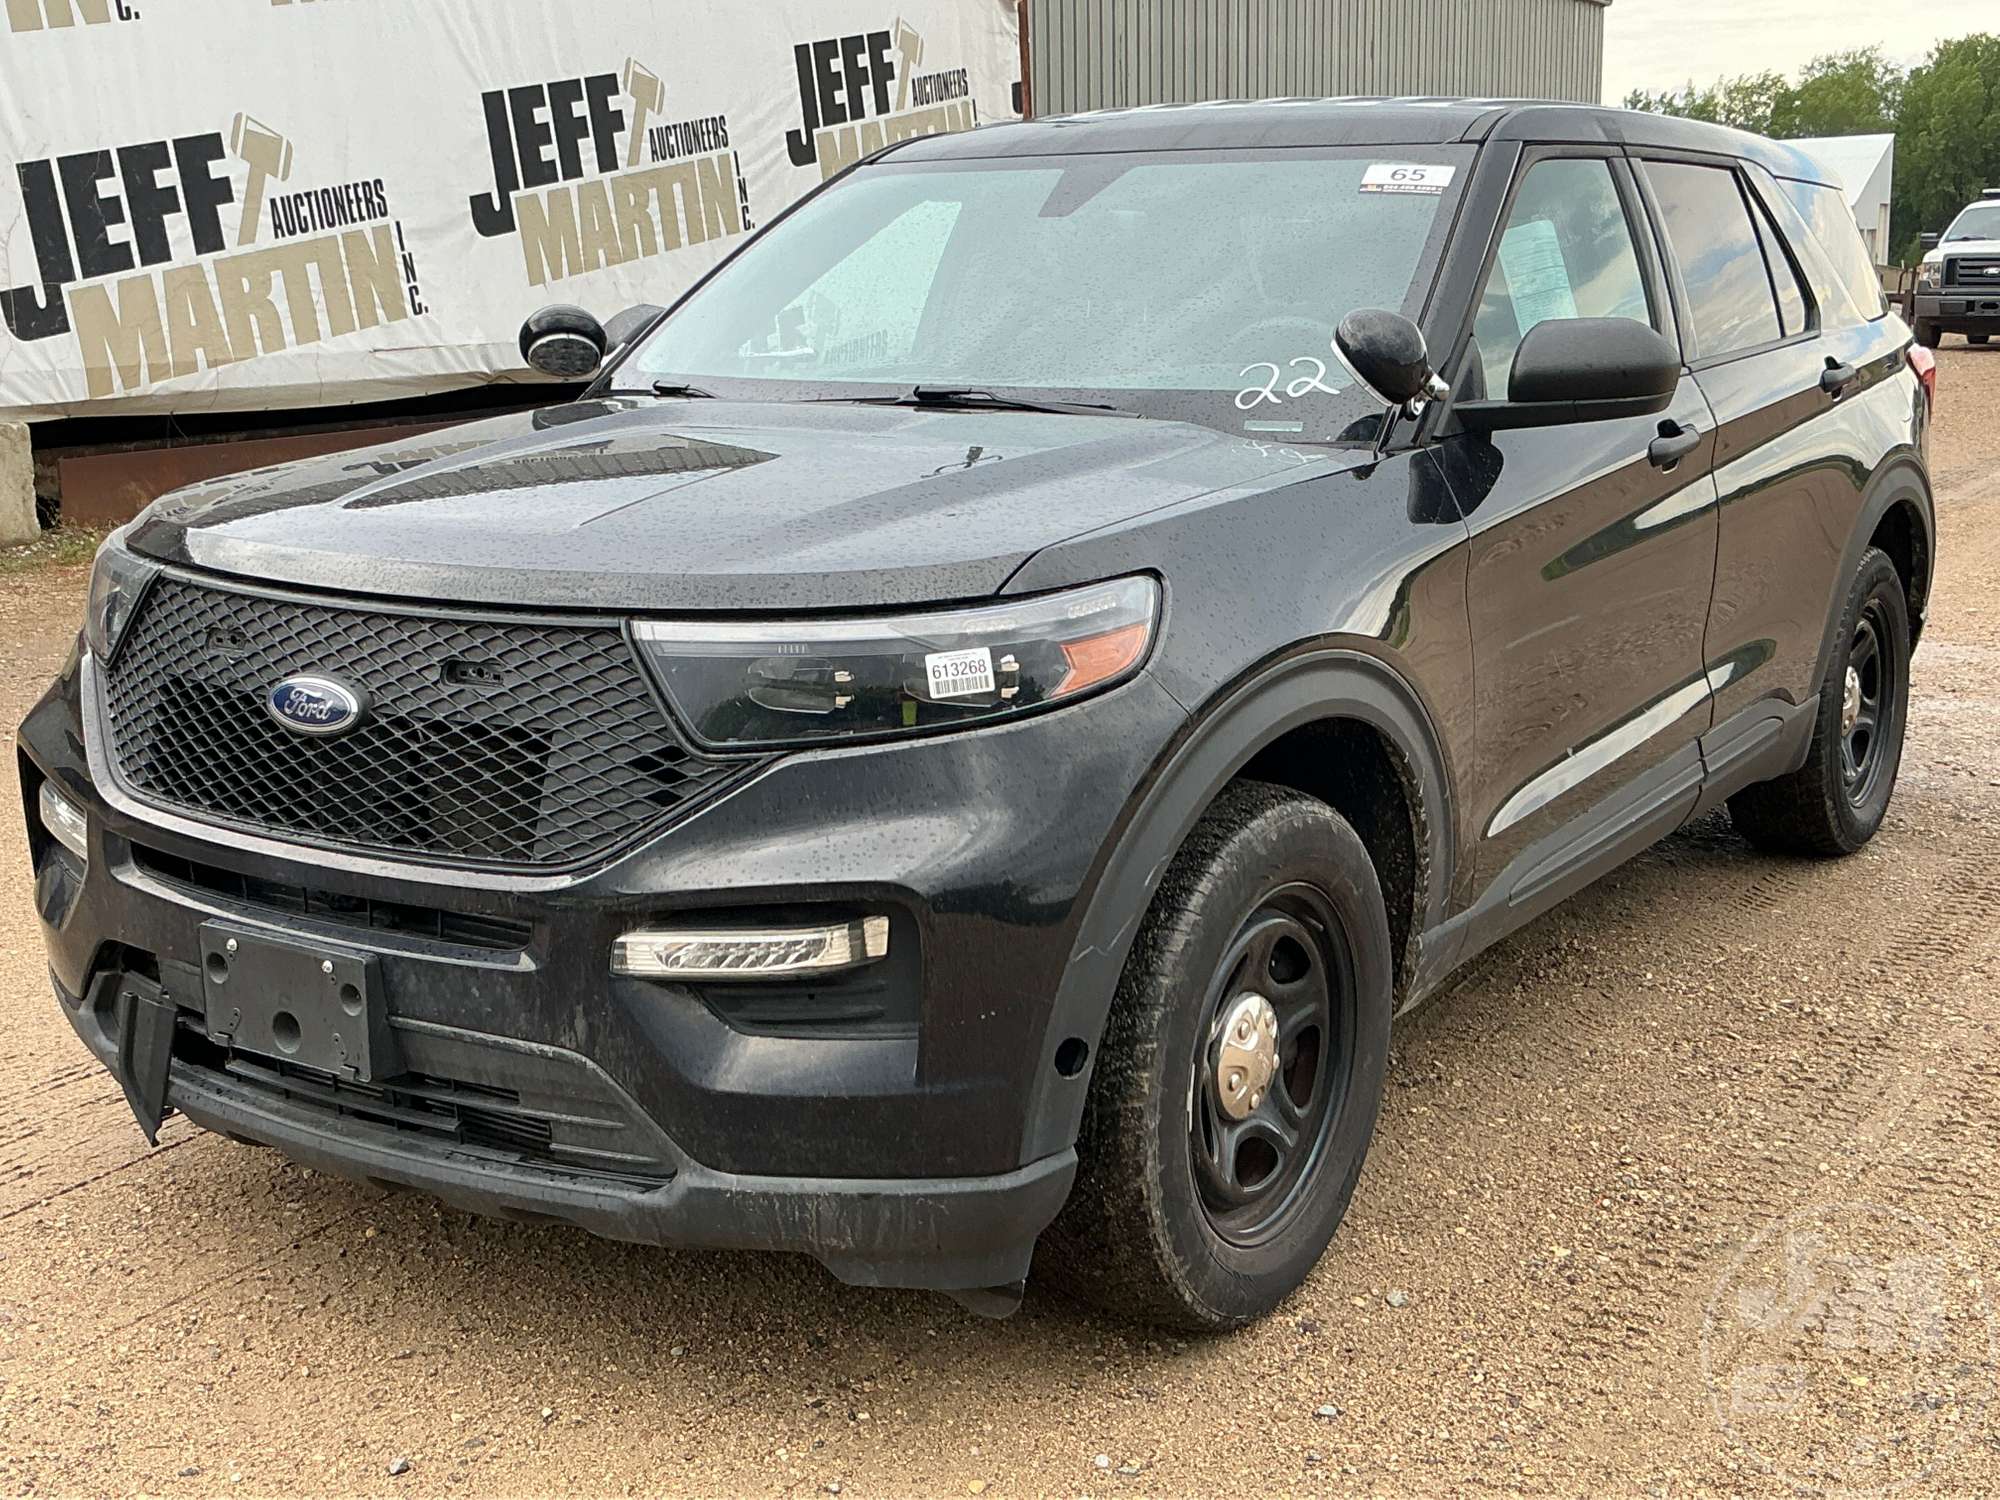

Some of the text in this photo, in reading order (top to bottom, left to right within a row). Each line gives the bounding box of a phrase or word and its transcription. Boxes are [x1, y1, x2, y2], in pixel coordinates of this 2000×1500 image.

[786, 31, 895, 167] JEFF
[911, 68, 969, 108] AUCTIONEERS
[469, 73, 626, 237] JEFF
[649, 115, 730, 162] AUCTIONEERS
[1390, 168, 1427, 182] 65
[0, 132, 235, 342] JEFF
[270, 178, 389, 240] AUCTIONEERS
[515, 153, 740, 287] MARTIN
[68, 224, 408, 400] MARTIN
[1235, 357, 1341, 410] 22
[932, 659, 987, 680] 613268
[284, 687, 334, 720] Ford
